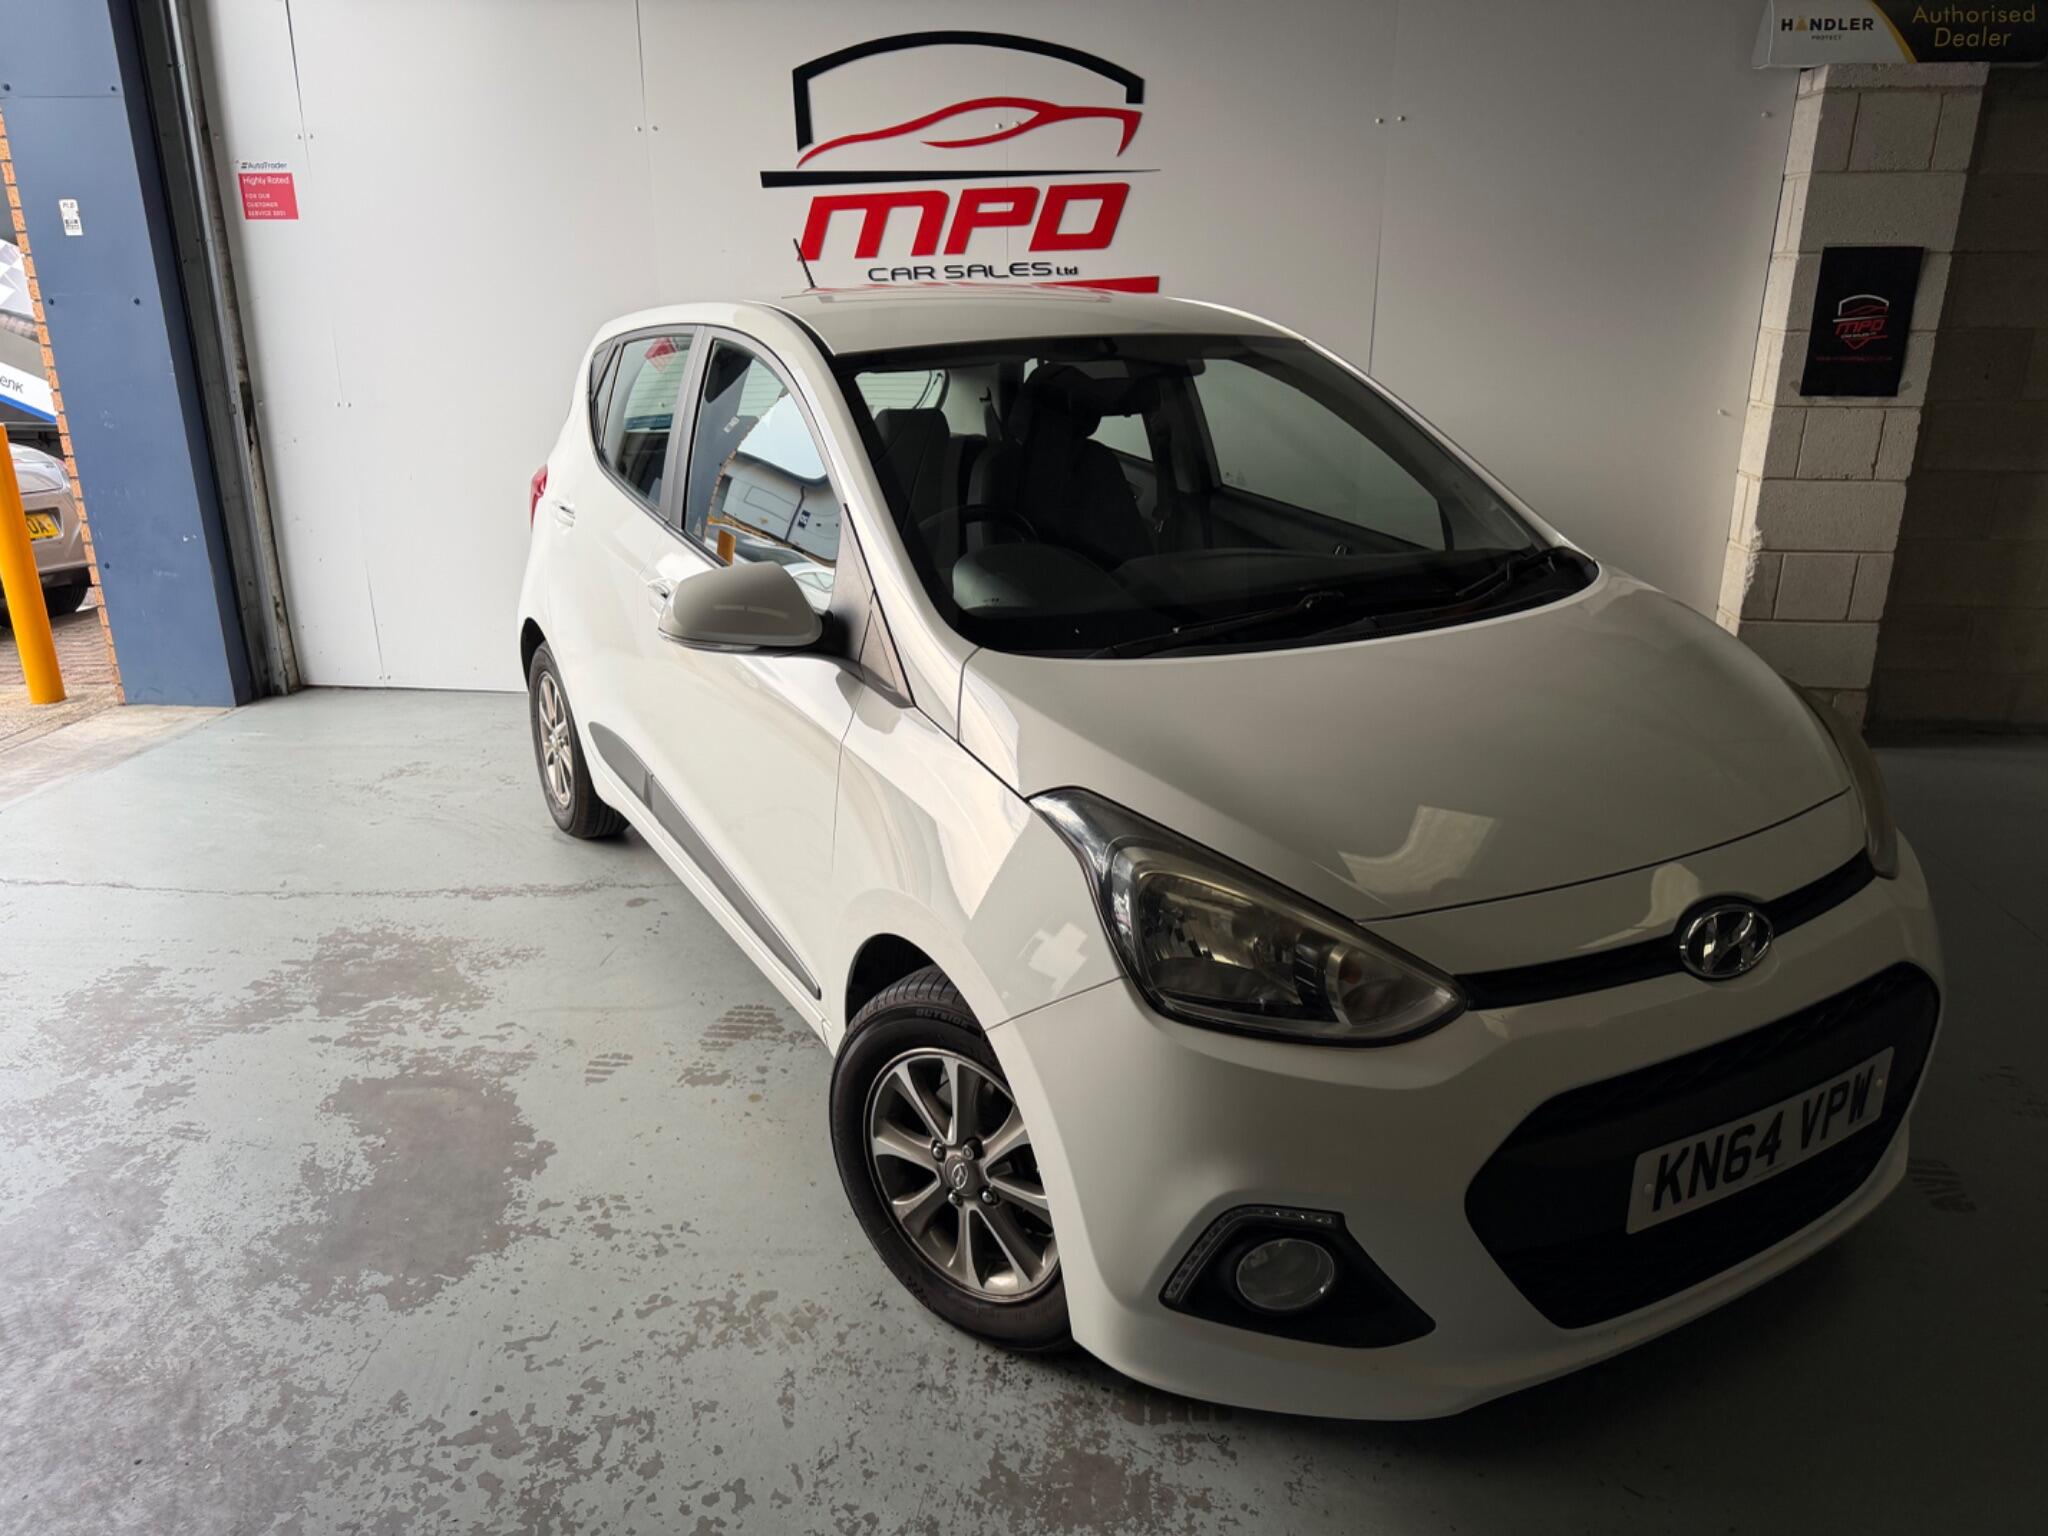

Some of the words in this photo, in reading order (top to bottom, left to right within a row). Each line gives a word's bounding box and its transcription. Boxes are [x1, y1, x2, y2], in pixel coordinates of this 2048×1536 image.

[1781, 17, 1874, 31] HANDLER
[1912, 4, 2036, 24] Authorised
[1934, 25, 2012, 47] Dealer
[242, 176, 266, 187] Highly
[267, 176, 290, 185] Rated
[797, 182, 1131, 261] MPD
[868, 265, 936, 282] CAR
[944, 261, 1052, 279] SALES
[1056, 265, 1079, 277] Ltd
[1652, 1110, 1784, 1212] KN64
[1801, 1064, 1875, 1150] VPW
